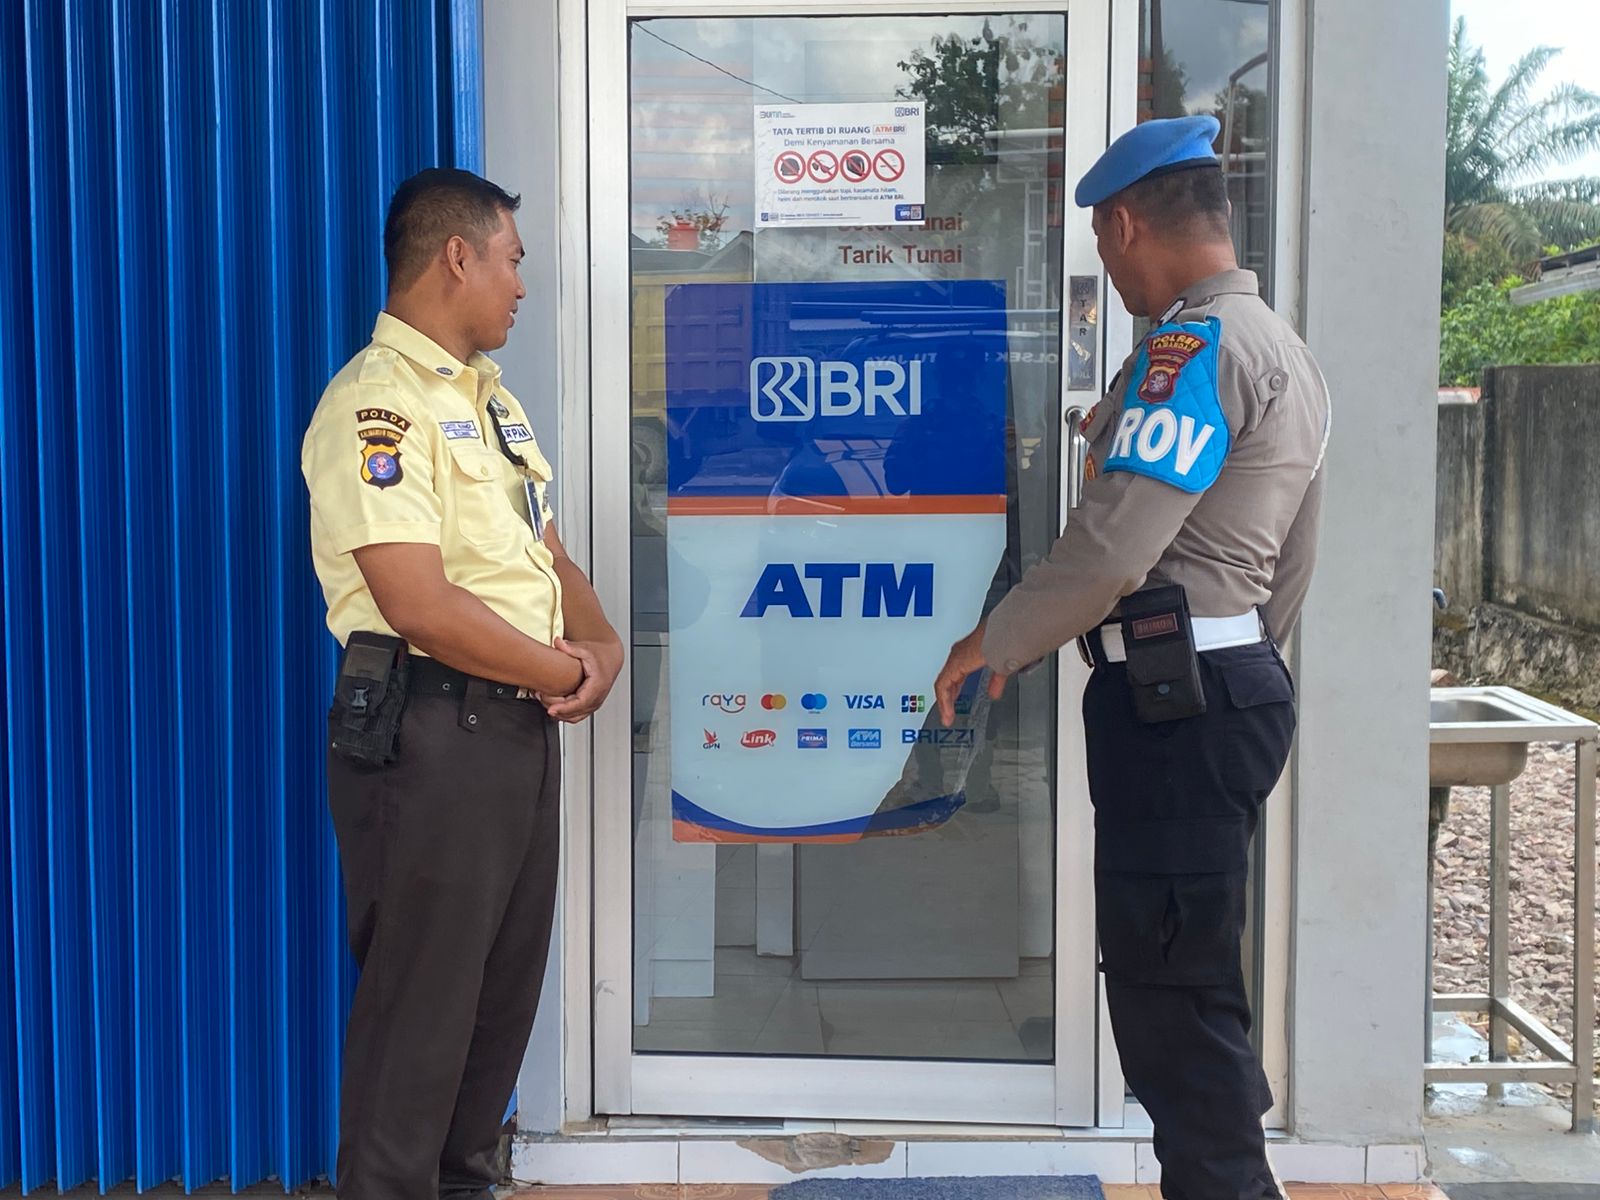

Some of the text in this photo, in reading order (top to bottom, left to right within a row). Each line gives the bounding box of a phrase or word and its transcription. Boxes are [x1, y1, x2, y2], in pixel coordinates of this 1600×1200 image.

[904, 107, 920, 116] BRI
[772, 128, 793, 136] TATA
[796, 127, 824, 135] TERTIB
[840, 126, 871, 134] RUANG
[784, 137, 895, 147] Demi Kenyamanan Bersama
[838, 244, 963, 264] Tarik Tunai
[819, 359, 922, 416] BRI
[360, 410, 406, 428] POLDA
[738, 562, 935, 618] ATM
[702, 694, 747, 708] raya
[843, 694, 885, 709] VISA
[901, 695, 925, 712] JCB
[742, 731, 775, 747] Link
[902, 729, 975, 743] BRIZZI
